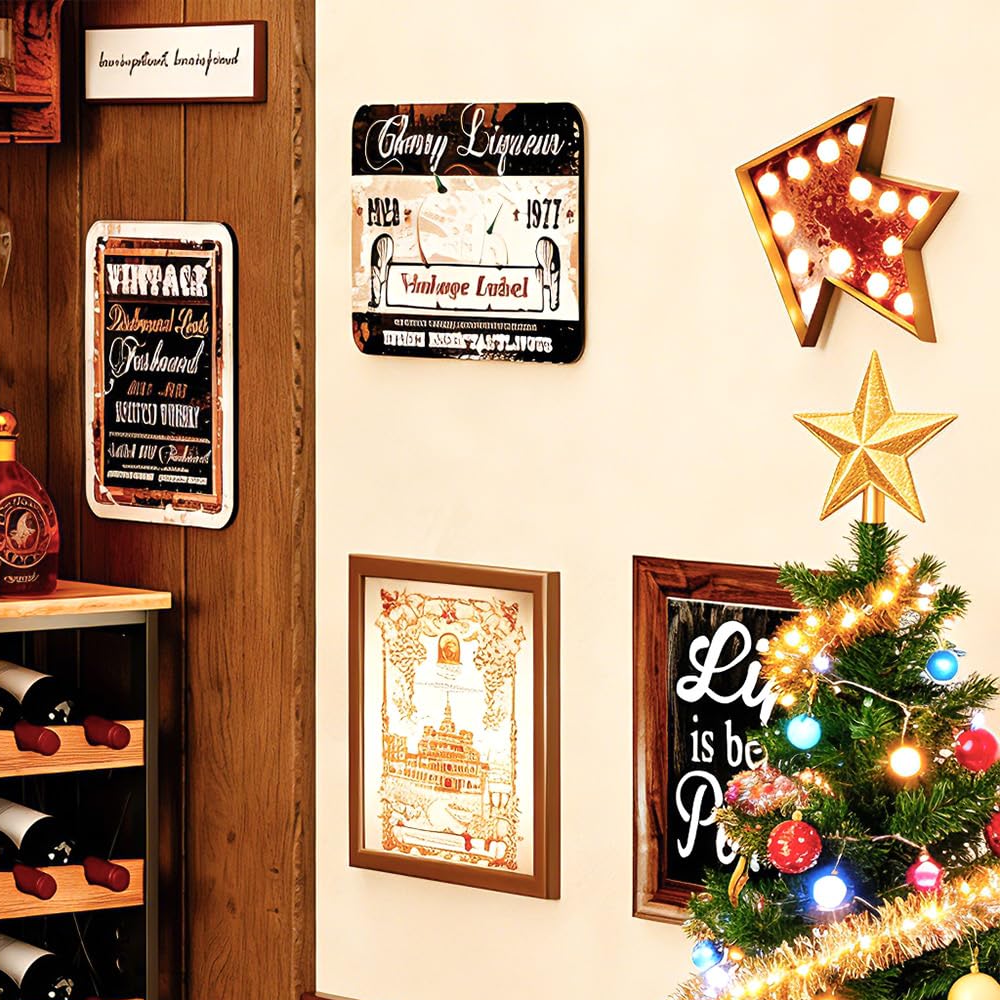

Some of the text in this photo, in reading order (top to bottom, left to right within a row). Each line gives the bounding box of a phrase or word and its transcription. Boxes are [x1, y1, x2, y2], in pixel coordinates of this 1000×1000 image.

[526, 198, 562, 229] 1977
[690, 714, 714, 763] is
[675, 769, 761, 873] Po
